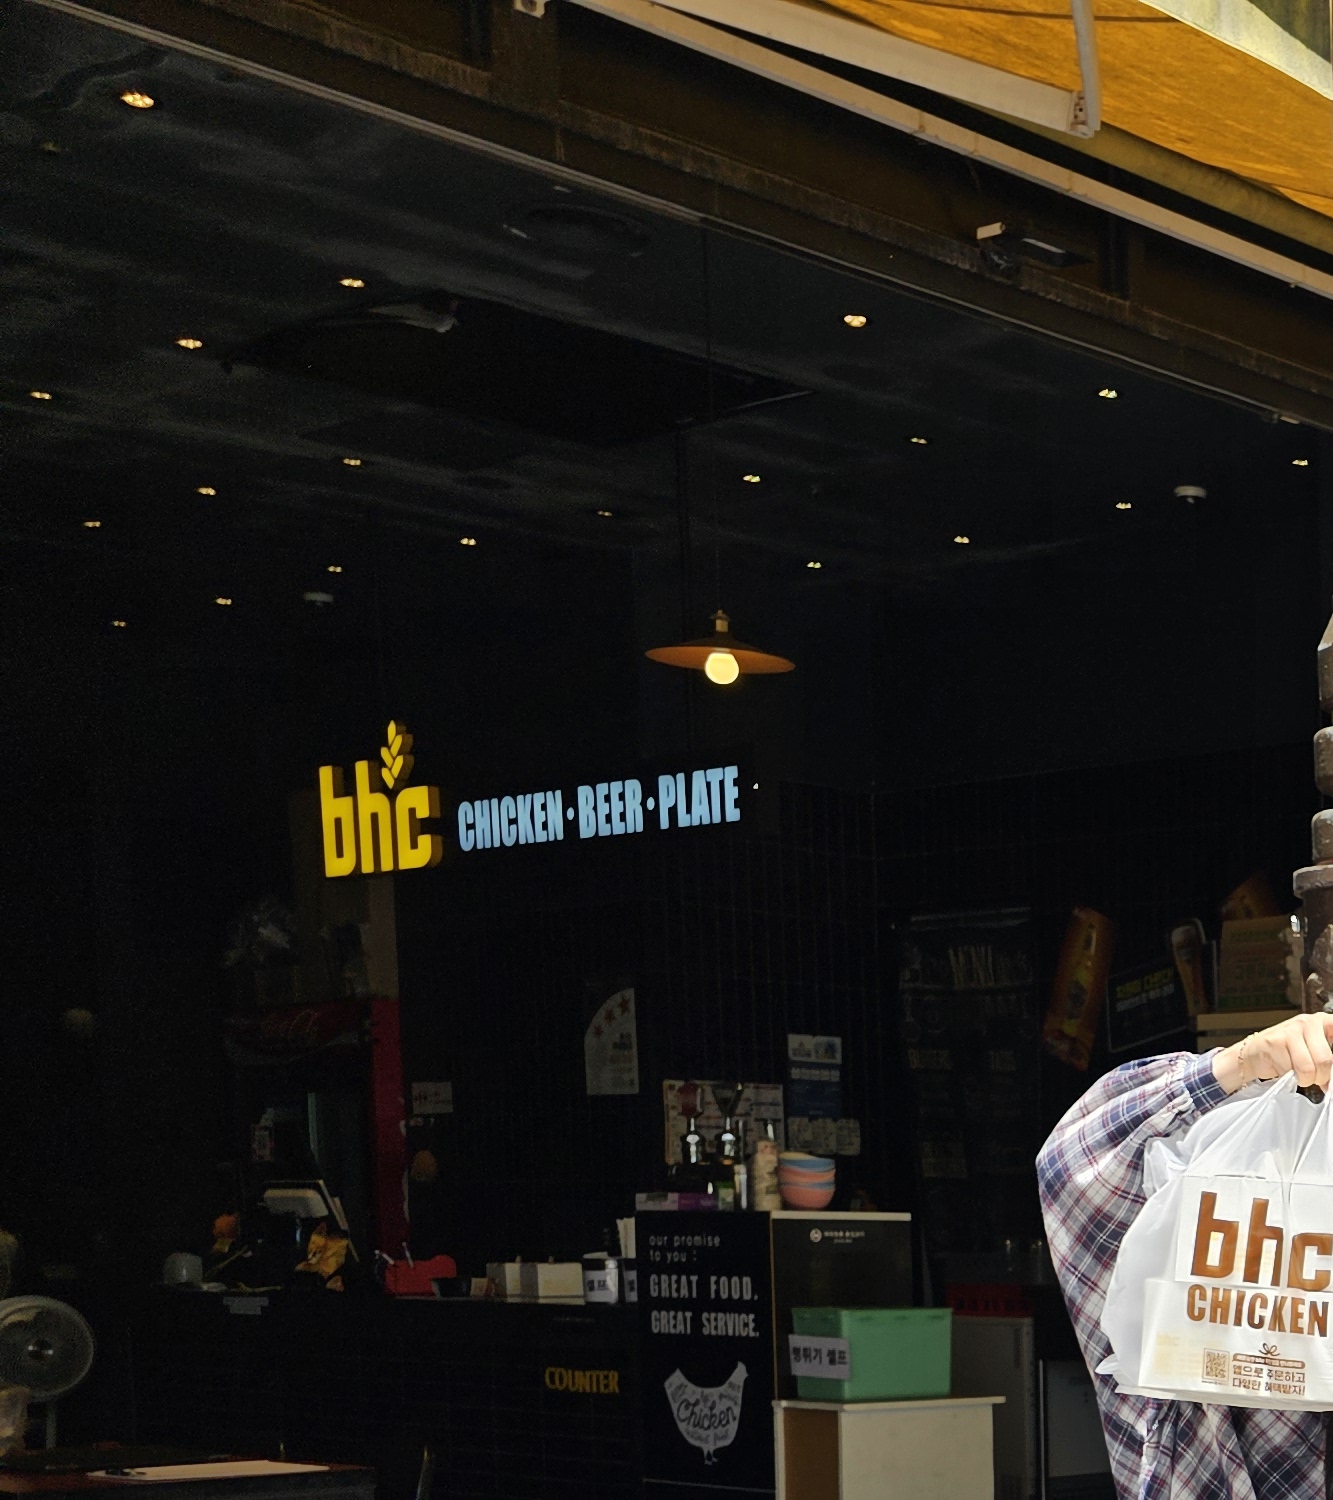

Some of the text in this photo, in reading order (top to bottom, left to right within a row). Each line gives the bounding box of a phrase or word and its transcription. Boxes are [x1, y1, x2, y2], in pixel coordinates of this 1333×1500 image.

[319, 760, 438, 878] bhc
[649, 1233, 720, 1247] our promise
[1191, 1191, 1333, 1293] bhc
[650, 1250, 687, 1264] to you
[650, 1274, 698, 1299] GREAT
[651, 1310, 760, 1338] GREAT SERVICE.
[1187, 1285, 1330, 1339] CHICKEN
[544, 1367, 620, 1394] COUNTER
[1266, 1368, 1306, 1383] 주문하고
[677, 1398, 737, 1431] Chicken
